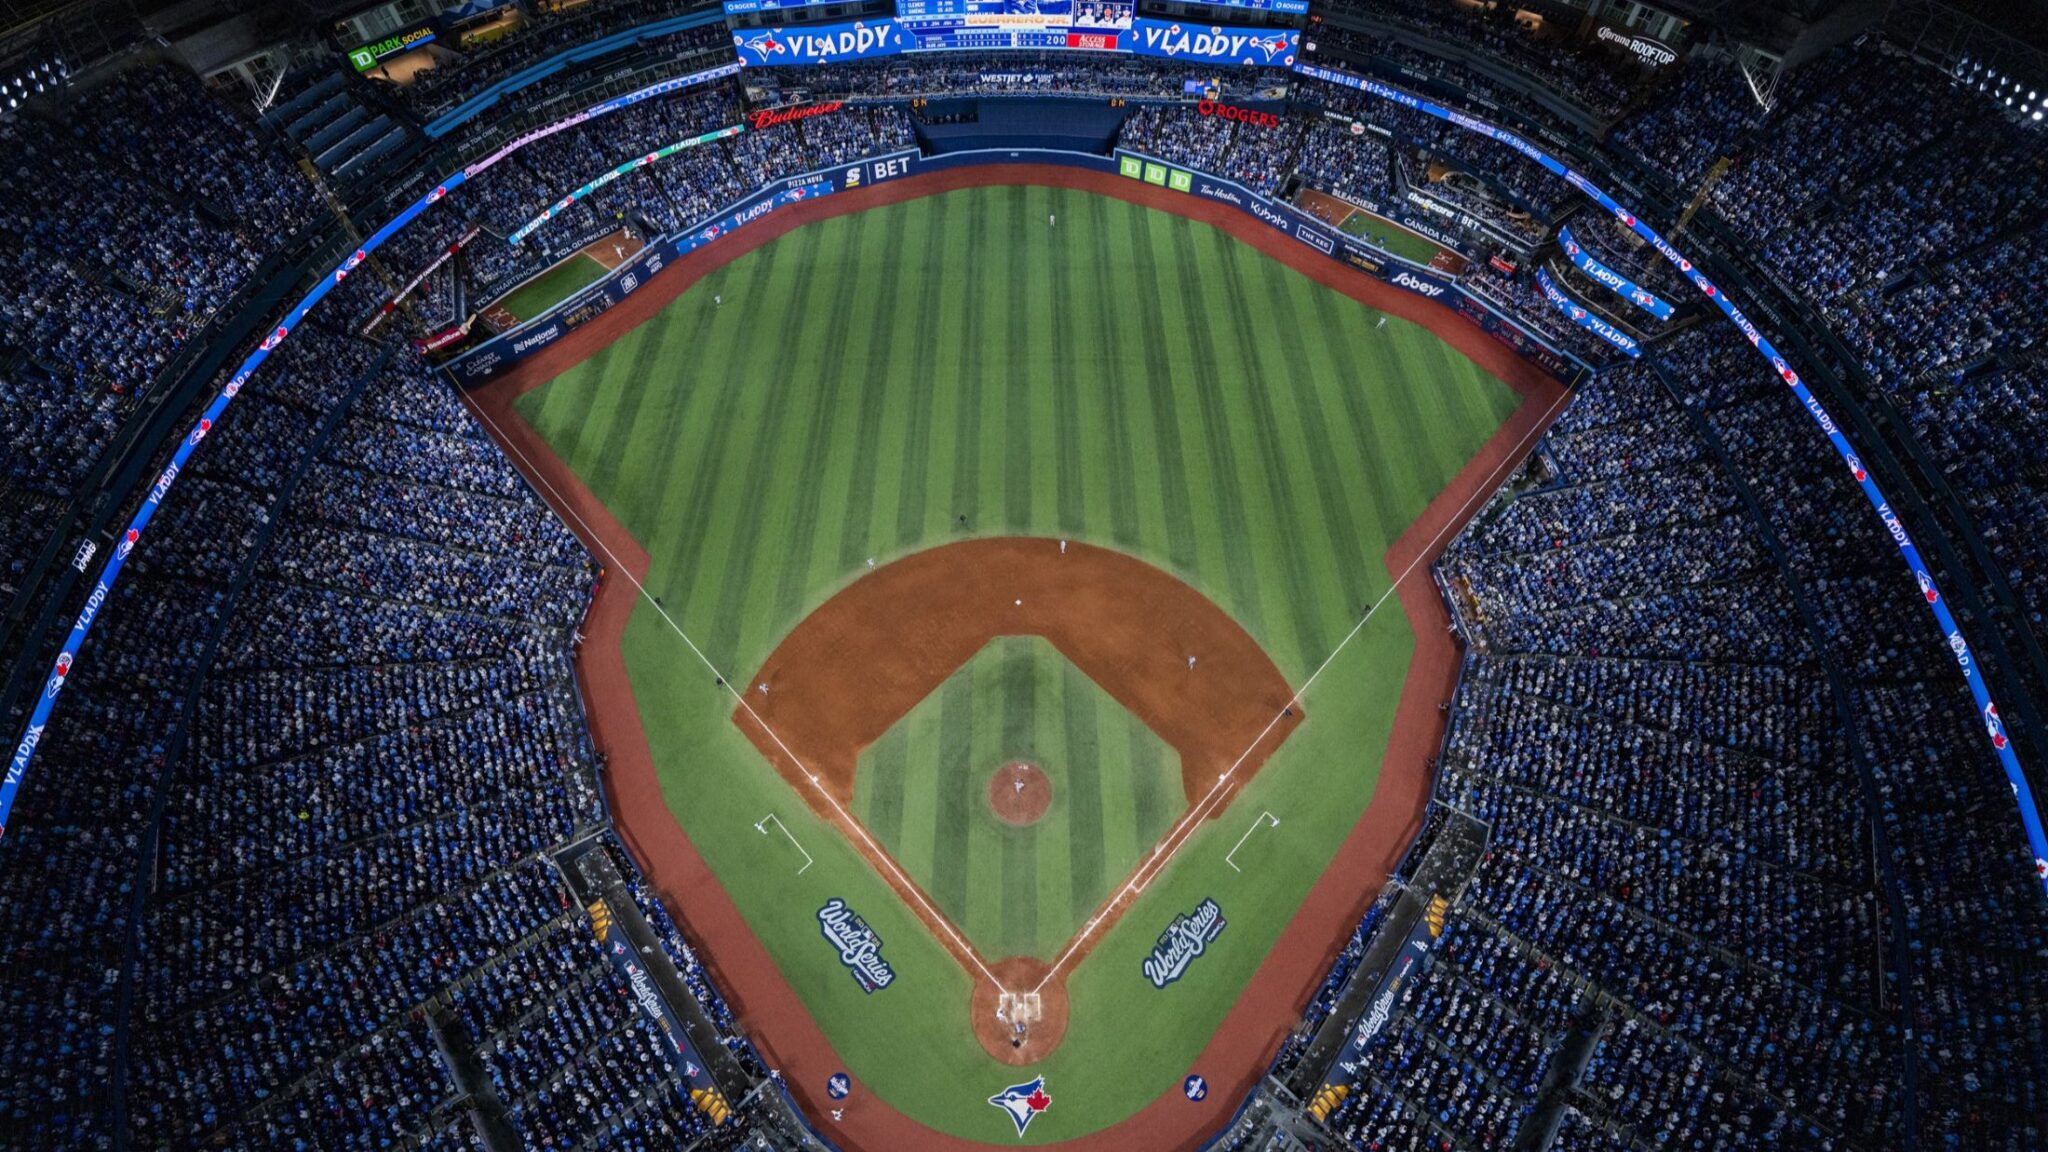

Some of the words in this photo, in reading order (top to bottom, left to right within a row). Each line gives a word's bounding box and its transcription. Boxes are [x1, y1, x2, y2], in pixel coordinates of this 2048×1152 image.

[967, 16, 1045, 25] GUERRERO
[350, 51, 374, 67] TD
[369, 36, 404, 57] PARK
[402, 27, 434, 45] SOCIAL
[787, 25, 891, 57] VLADDY
[1079, 34, 1106, 43] ACCESS
[1146, 27, 1248, 57] VLADDY
[1596, 25, 1632, 48] Corona
[1629, 39, 1676, 65] ROOFTOP
[1637, 55, 1658, 67] PATIO
[980, 74, 1023, 84] WESTJET
[748, 100, 843, 129] Budweiser
[1216, 103, 1279, 129] ROGERS
[1496, 131, 1542, 160] 647-559-0060
[874, 157, 910, 179] BET
[1125, 160, 1139, 174] TD
[1150, 167, 1163, 181] TD
[1174, 174, 1189, 188] TD
[787, 178, 807, 189] PIZZA
[806, 175, 824, 186] NOVA
[1200, 184, 1214, 196] Tim
[1213, 188, 1242, 205] Hortons
[734, 198, 774, 225] VLADDY
[1331, 188, 1380, 213] BLEACHERS
[1407, 191, 1455, 218] theScore
[1460, 215, 1481, 231] BET
[515, 217, 545, 239] VLADDY
[1250, 201, 1288, 230] Kubota
[553, 248, 571, 260] TCL
[608, 222, 620, 232] TV
[1301, 230, 1314, 240] THE
[1403, 217, 1440, 240] CANADA
[1441, 232, 1461, 248] DRY
[1652, 235, 1682, 265] VLADDY
[474, 294, 493, 308] TCL
[491, 262, 543, 297] SMARTPHONE
[1391, 272, 1444, 297] Sobeys
[1582, 257, 1626, 289] VLADDY
[1540, 273, 1567, 304] VLADDY
[523, 323, 559, 348] National
[1594, 322, 1636, 350] VLADDY
[466, 352, 496, 370] CLEARLY
[466, 355, 502, 377] CANADIAN
[1805, 395, 1839, 437] VLADDY
[149, 461, 180, 506] VLADDY
[1877, 503, 1912, 549] VLADDY
[77, 543, 97, 574] KPMG
[73, 580, 109, 632] VLADDY
[819, 900, 863, 952] World
[842, 941, 893, 987] Series
[1144, 930, 1191, 986] World
[1180, 900, 1218, 955] Series
[630, 969, 654, 1000] World
[638, 993, 663, 1019] Series
[1358, 1009, 1382, 1039] World
[1374, 989, 1395, 1021] Series
